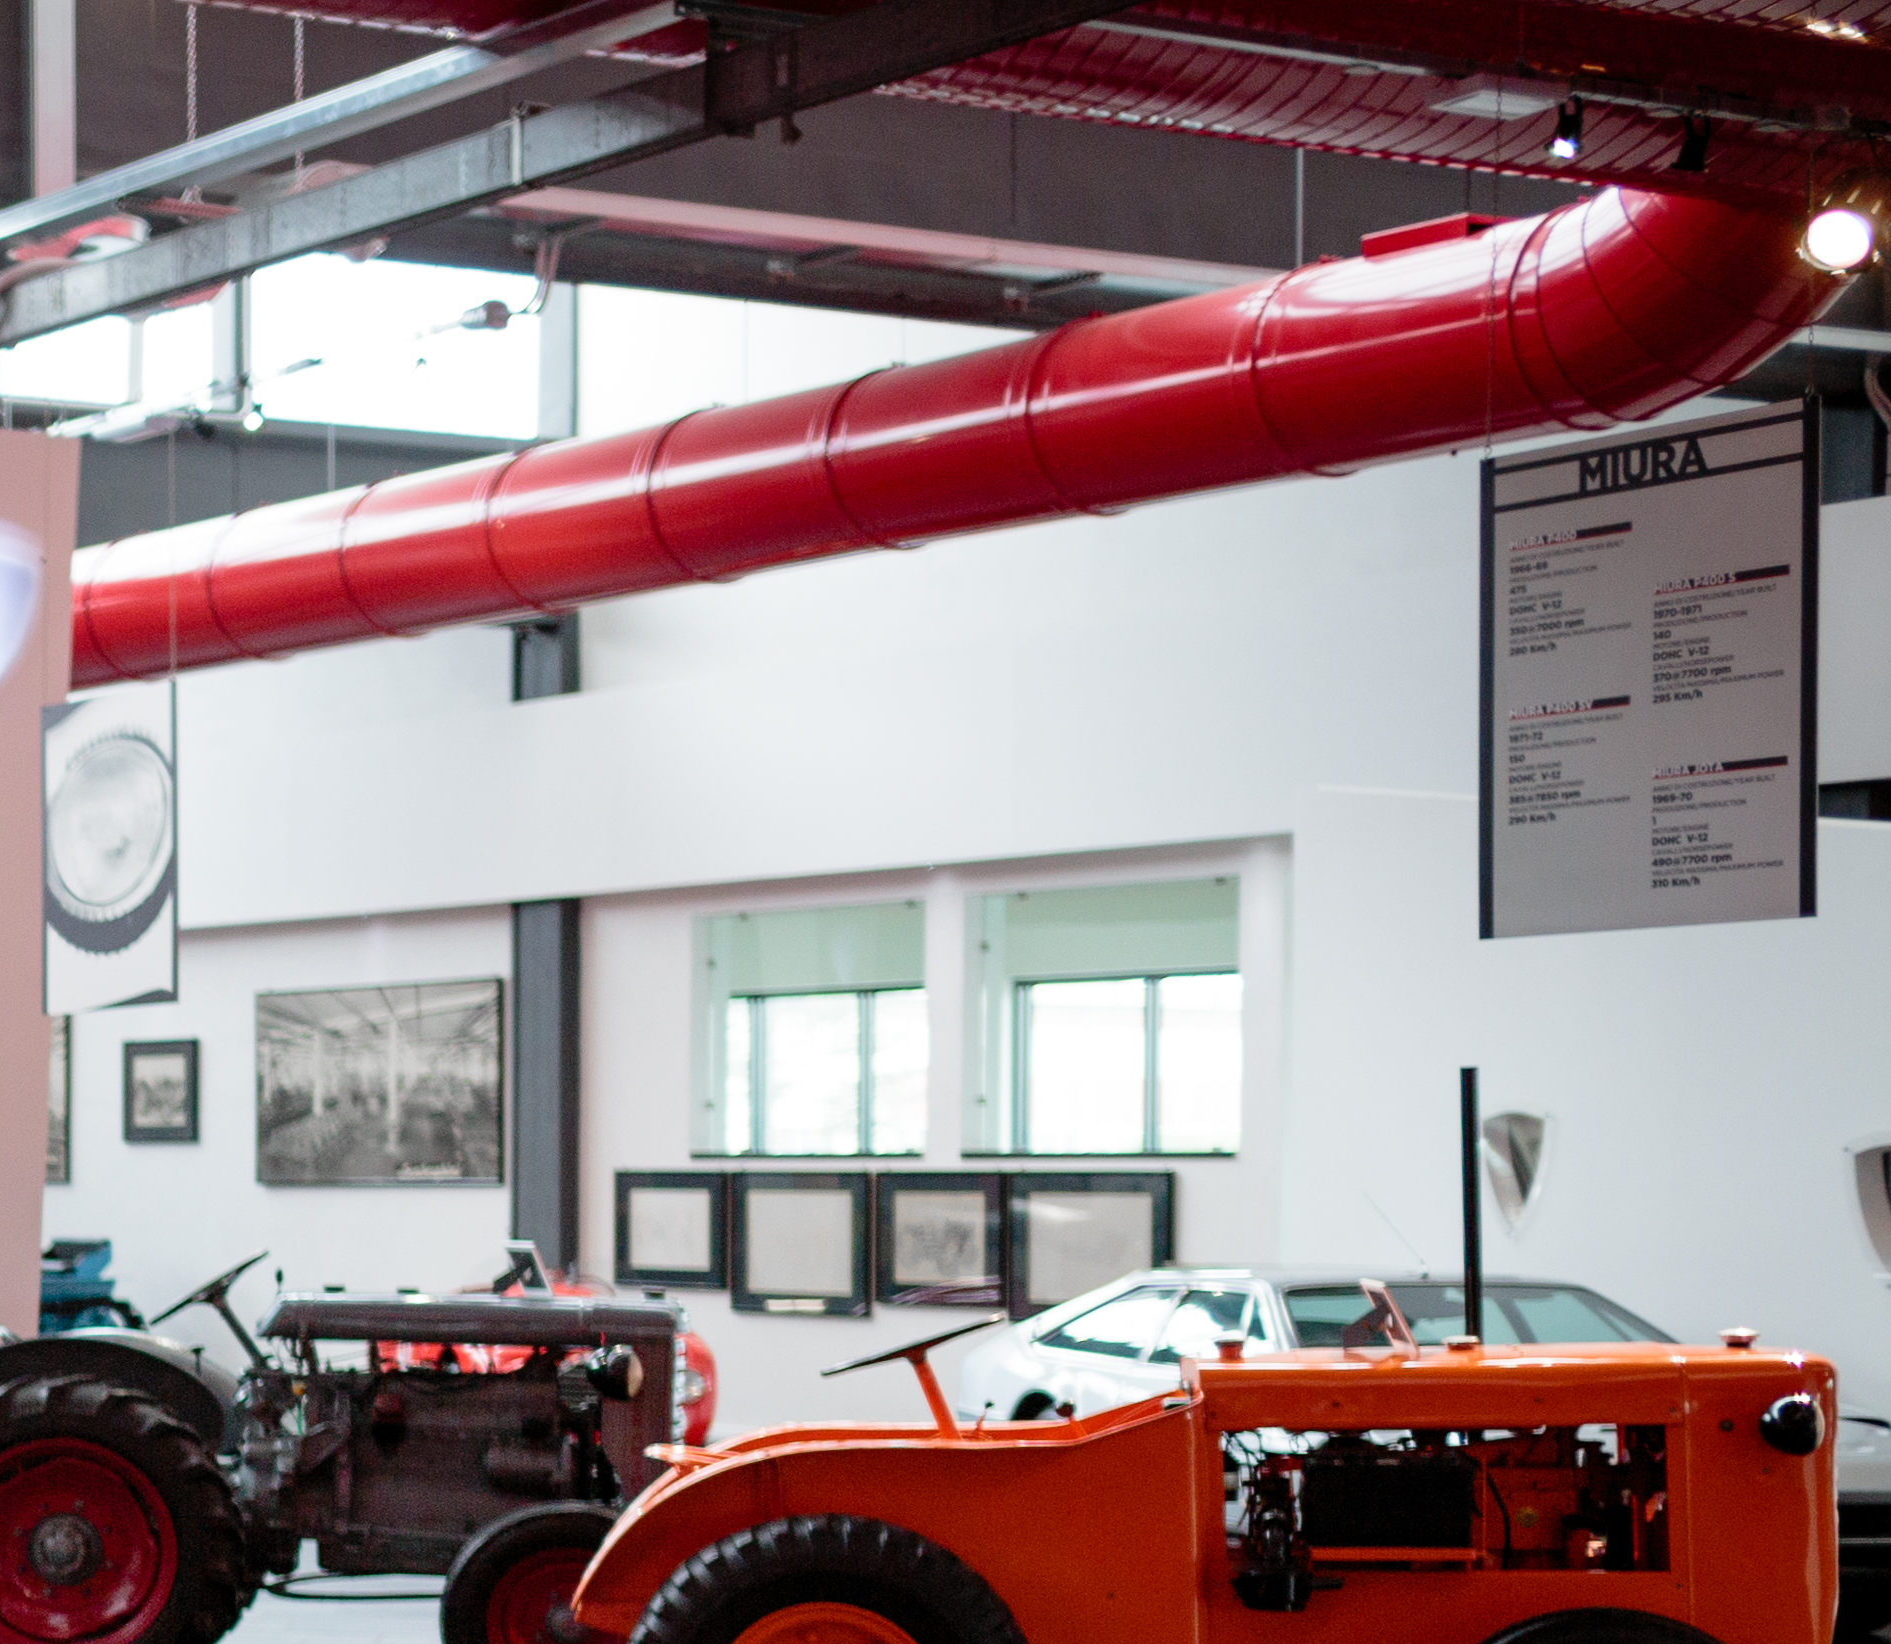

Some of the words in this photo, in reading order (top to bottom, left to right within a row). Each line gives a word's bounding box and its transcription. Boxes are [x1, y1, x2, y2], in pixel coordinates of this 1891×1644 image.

[1580, 435, 1708, 494] MIURA
[1510, 535, 1543, 550] MIURA
[1654, 579, 1690, 594] MIURA
[1564, 618, 1583, 629] rpm
[1710, 665, 1731, 676] rpm
[1509, 705, 1542, 719] MIURA
[1653, 764, 1688, 778] MIURA
[1561, 790, 1580, 800] rpm
[1711, 853, 1731, 863] rpm
[1652, 878, 1668, 888] 310
